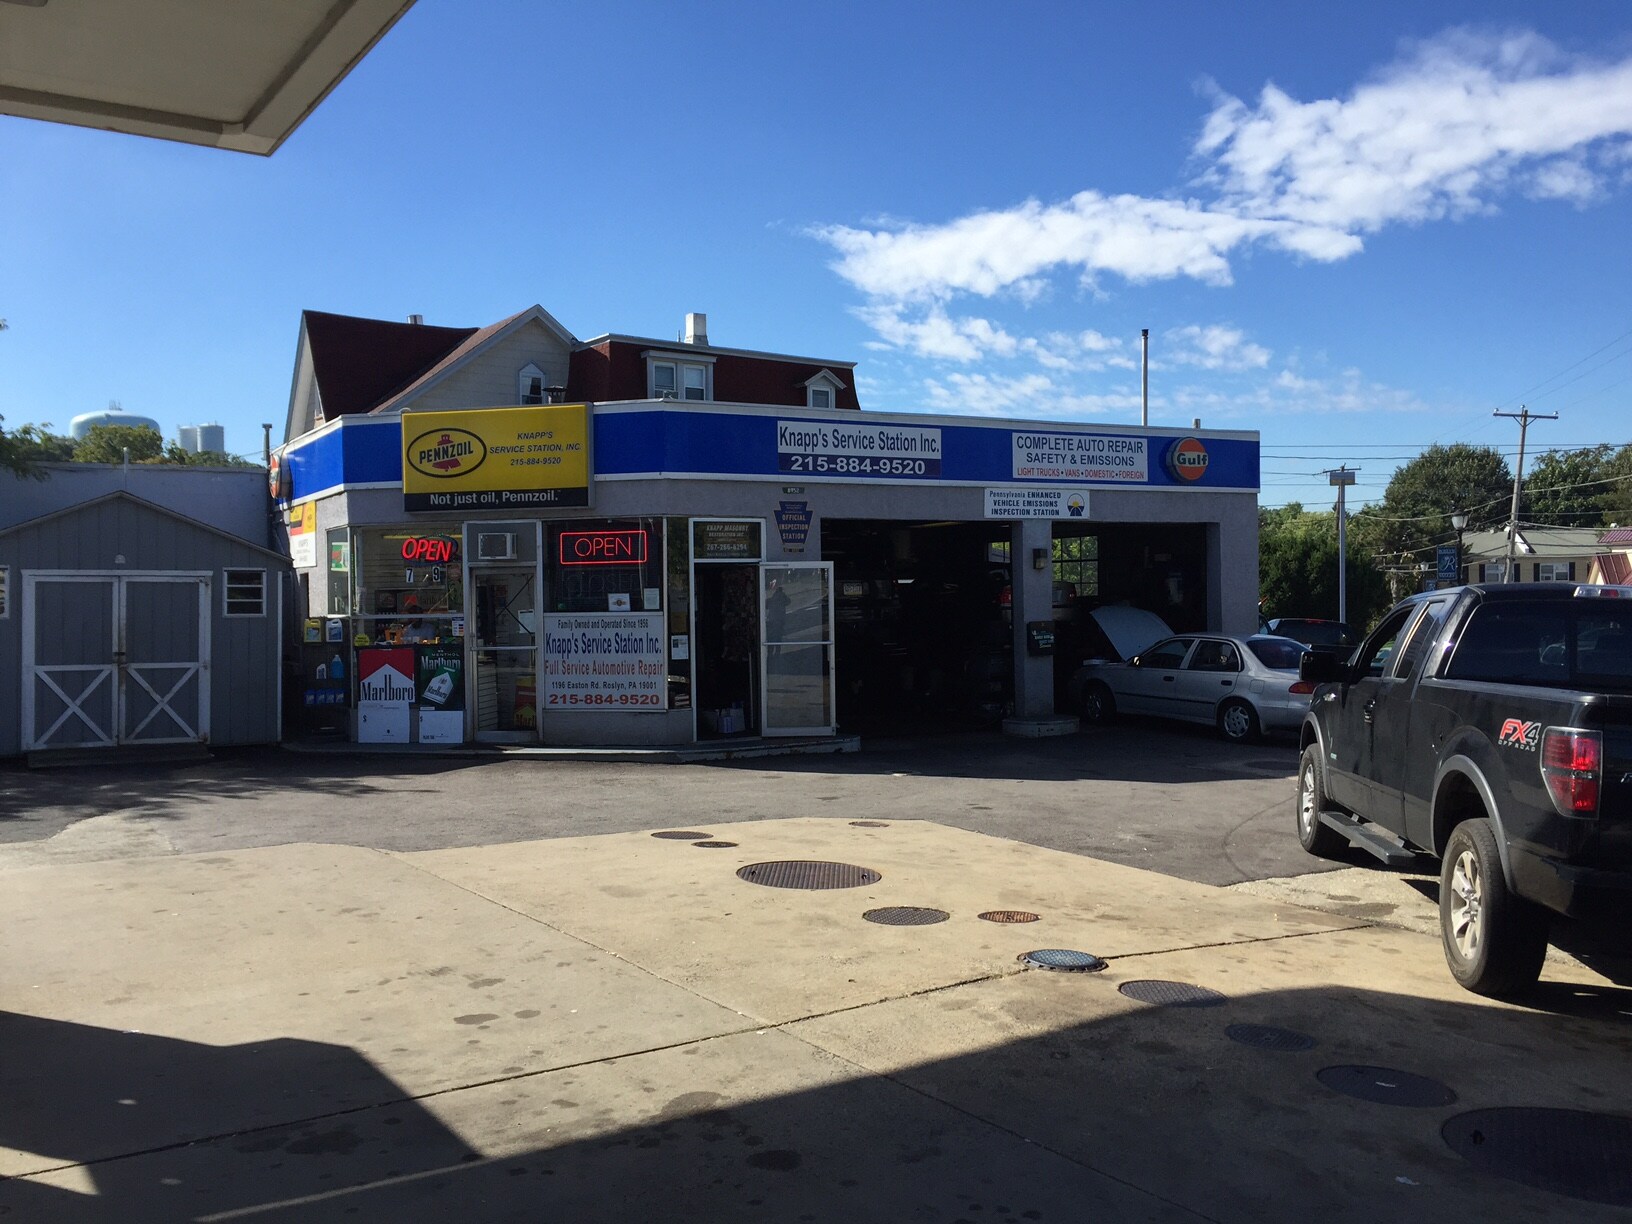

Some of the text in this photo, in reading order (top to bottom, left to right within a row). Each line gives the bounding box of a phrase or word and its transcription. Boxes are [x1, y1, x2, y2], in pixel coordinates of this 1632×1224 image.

[517, 431, 553, 440] KNAPP'S
[779, 426, 940, 453] Knapp's Service Station Inc.
[489, 445, 524, 454] SERVICE
[565, 443, 582, 451] INC.
[1016, 436, 1144, 454] COMPLETE AUTO REPAIR
[419, 441, 474, 465] PENNZOIL
[1026, 452, 1135, 466] SAFETY & EMISSIONS
[1176, 453, 1208, 466] Gulf
[510, 457, 562, 466] 215-884-9520
[790, 455, 926, 475] 215-884-9520
[1017, 467, 1145, 480] LIGHT TRUCKS VANS DOMESTIC FOREIGN
[430, 490, 559, 506] Not just oil, Pennzoil.
[989, 489, 1062, 499] Pennsylvania ENHANCED
[993, 499, 1059, 508] VEHICLE EMISSIONS
[991, 508, 1060, 517] INSPECTION STATION
[401, 537, 453, 562] OPEN
[574, 536, 631, 557] OPEN
[406, 567, 440, 582] 7 9
[558, 619, 573, 631] Family
[574, 620, 591, 629] Owned
[591, 619, 600, 629] and
[600, 619, 622, 630] Operated
[623, 619, 636, 628] Since
[545, 632, 662, 659] Knapp's Service Station Inc.
[421, 656, 461, 671] Marlboro
[544, 660, 663, 677] Full Service Automotive Repair
[361, 674, 414, 701] Marlboro
[551, 681, 566, 689] 1196
[567, 681, 589, 689] Easton
[602, 681, 627, 690] Roslyn,
[628, 681, 637, 689] PA
[638, 681, 657, 690] 19001
[549, 694, 660, 705] 215-884-9520
[1499, 718, 1542, 746] FX4
[1515, 743, 1536, 752] ROAD
